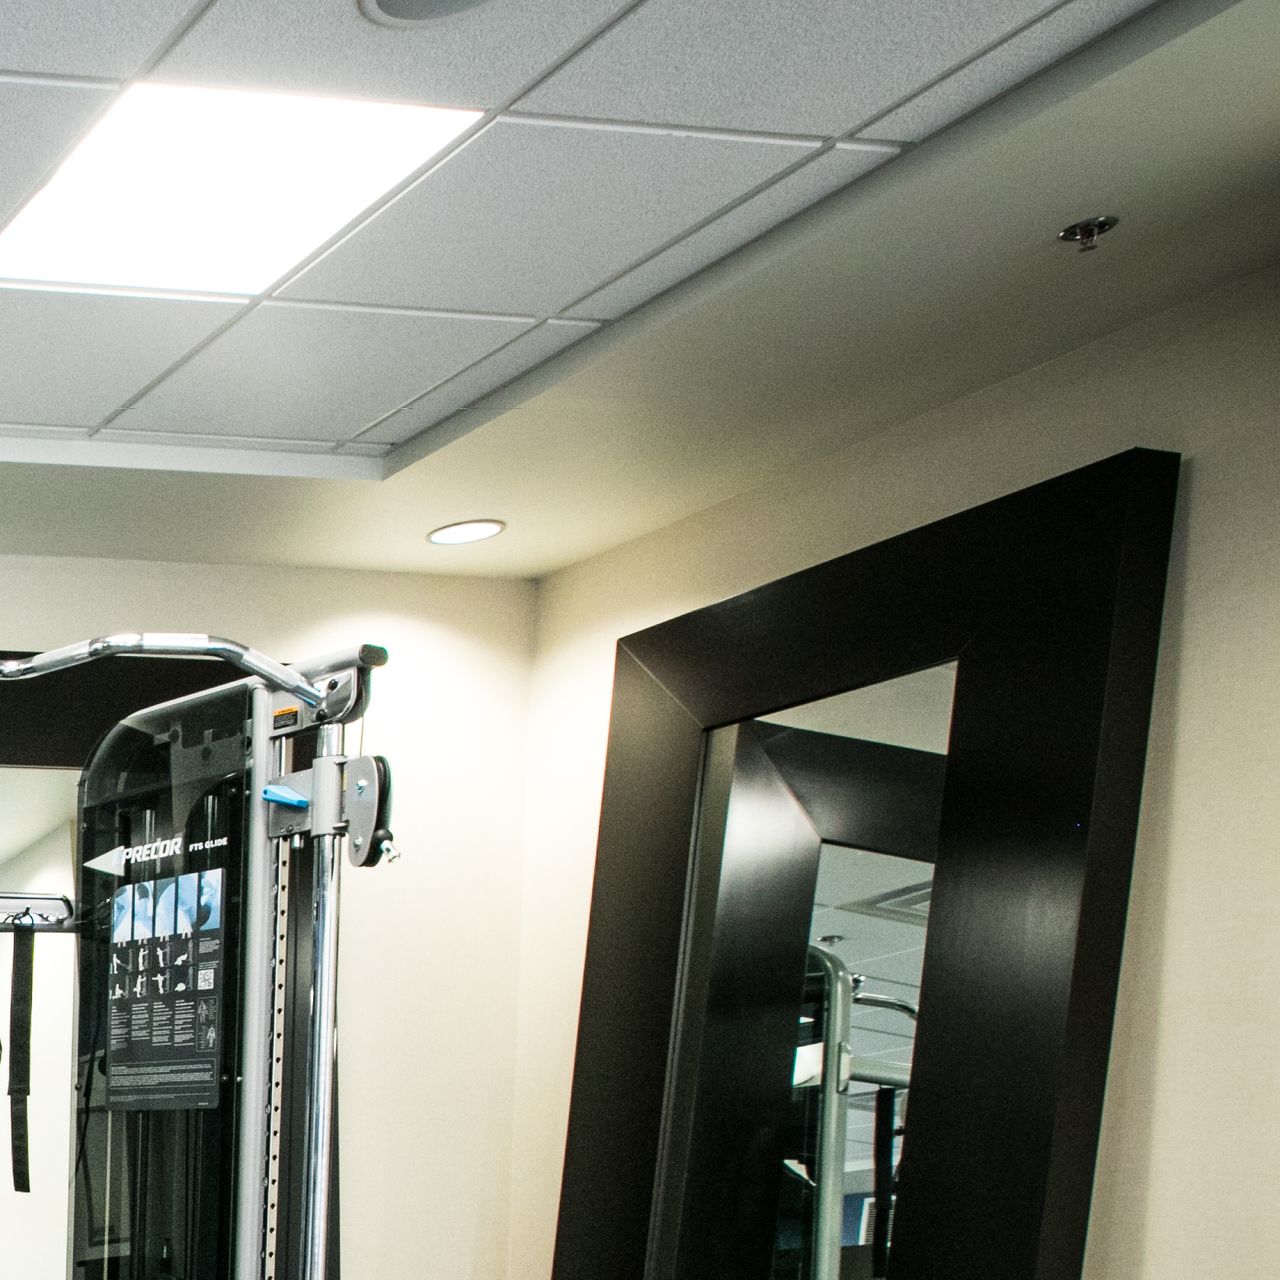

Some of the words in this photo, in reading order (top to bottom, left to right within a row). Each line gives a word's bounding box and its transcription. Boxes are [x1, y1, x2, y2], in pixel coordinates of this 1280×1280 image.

[121, 836, 183, 865] PRECOR
[189, 843, 204, 852] FTS
[204, 837, 228, 850] GLIDE
